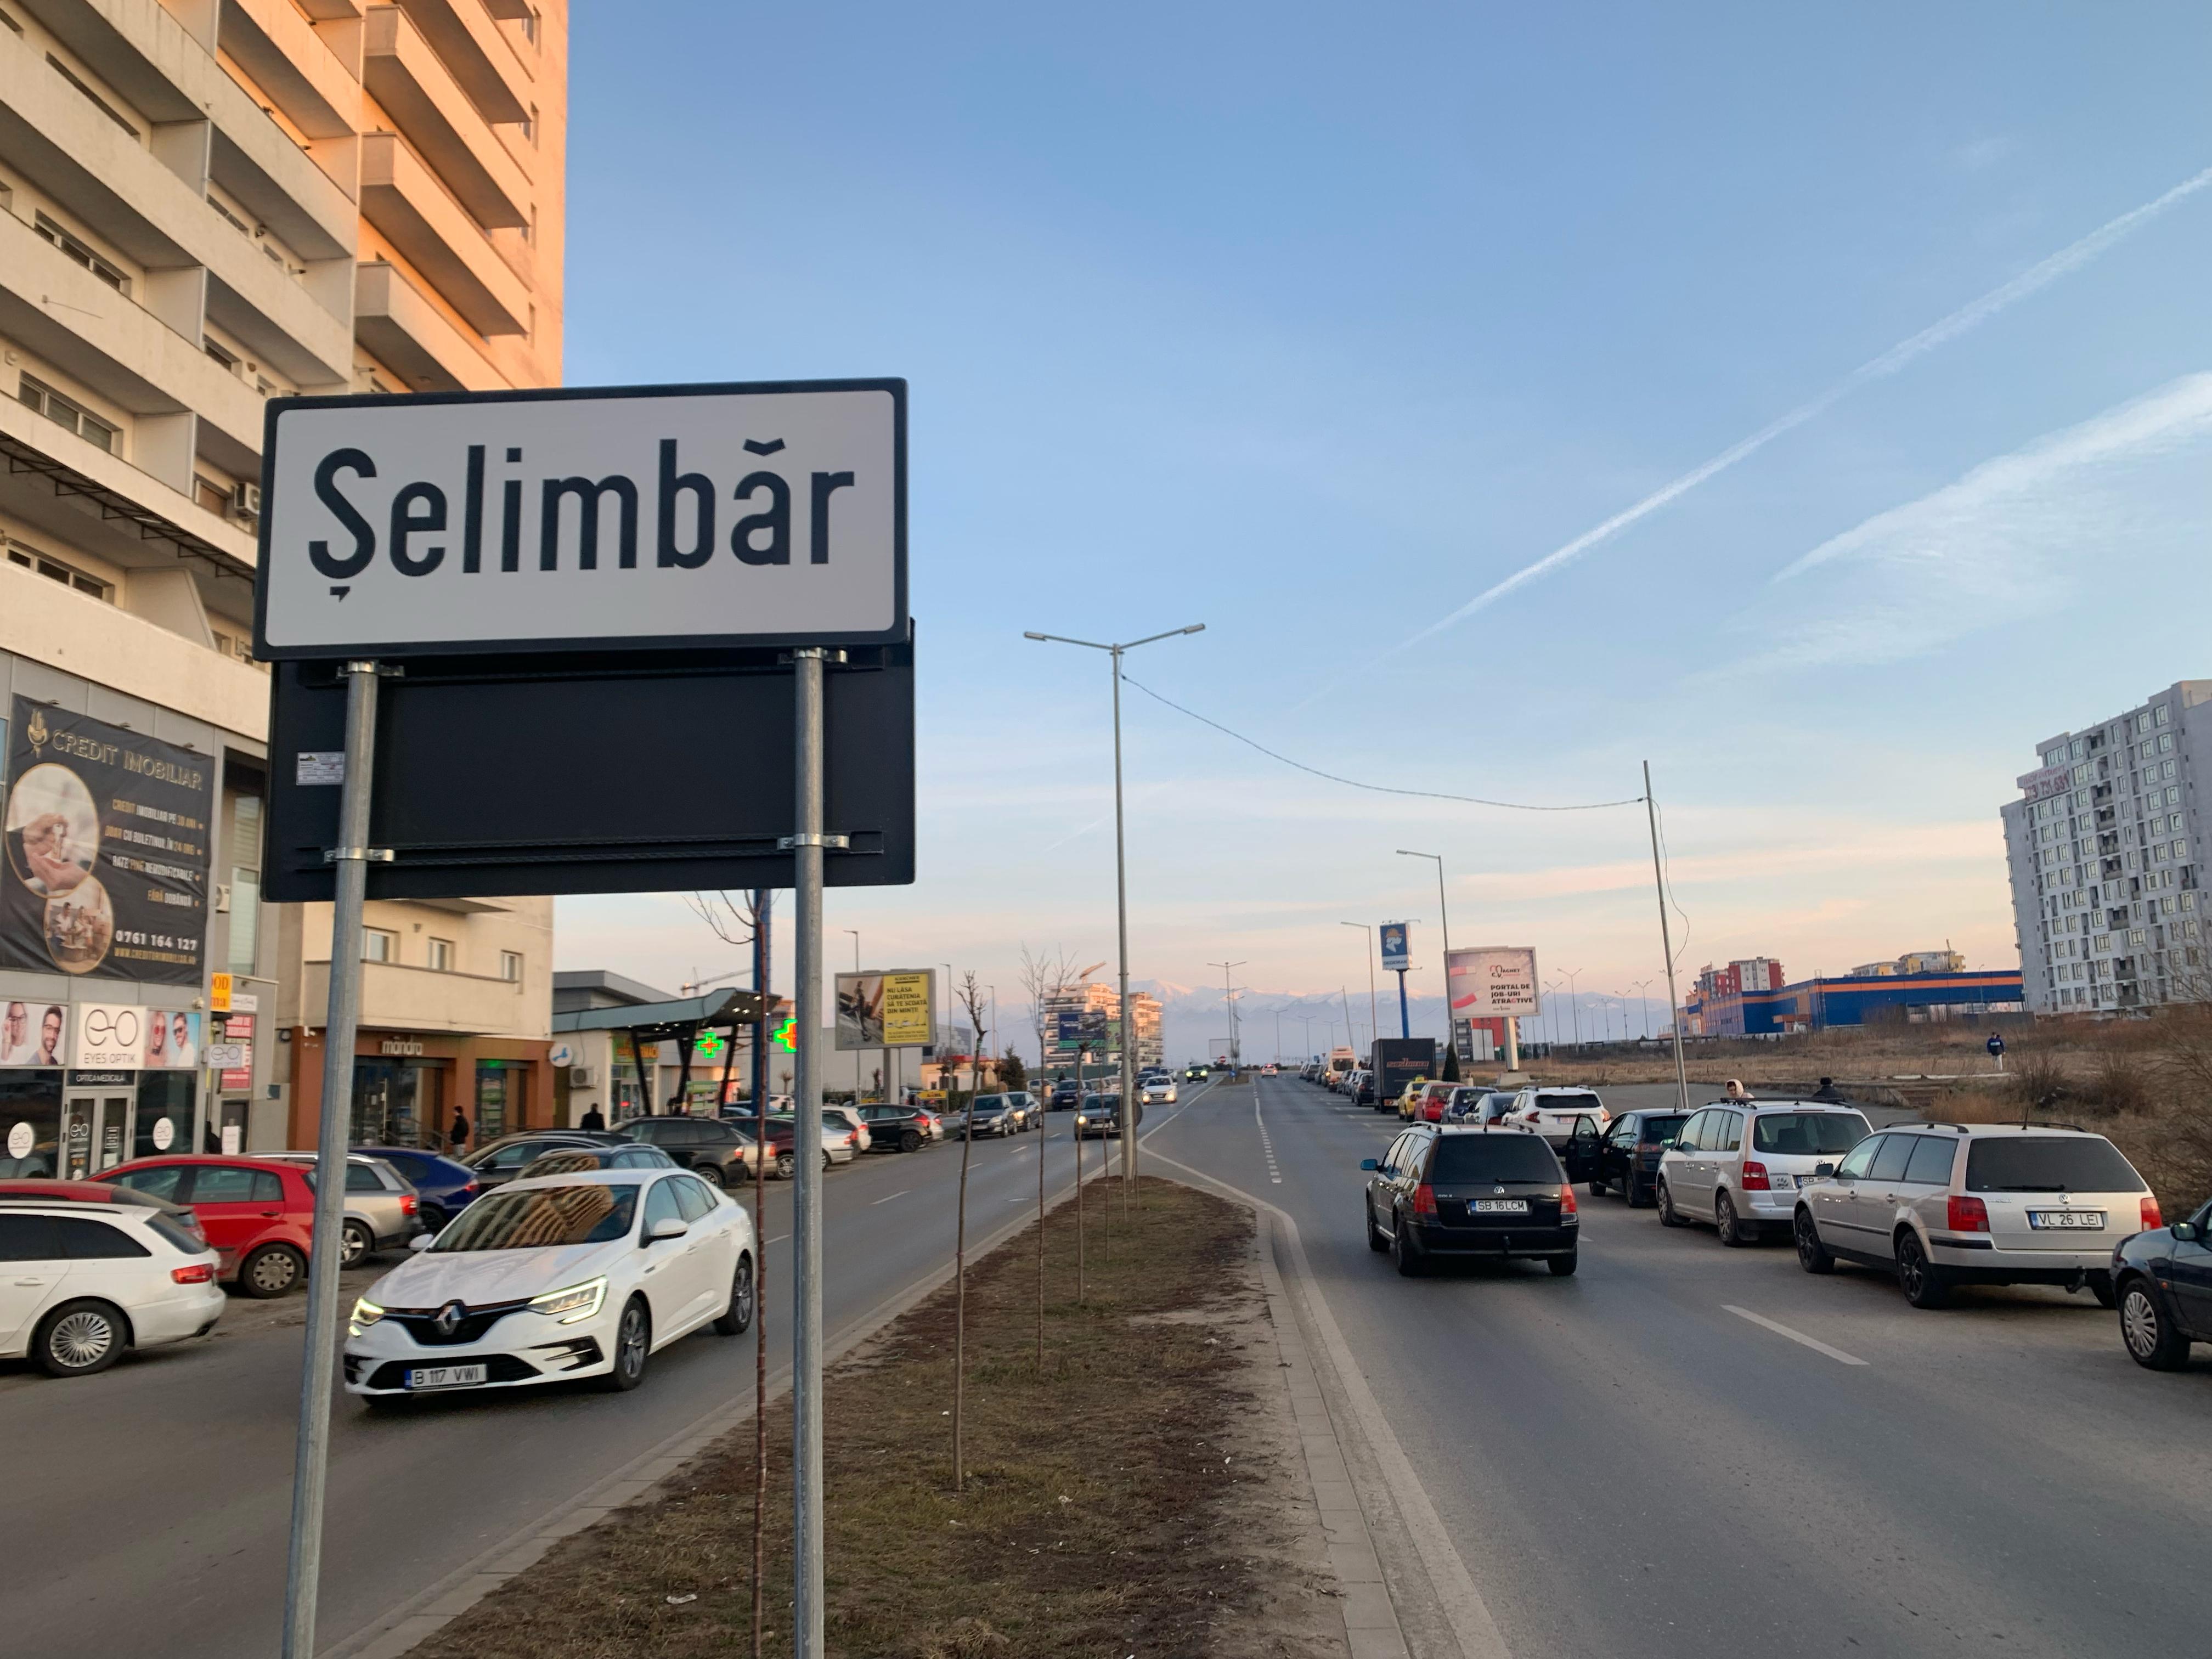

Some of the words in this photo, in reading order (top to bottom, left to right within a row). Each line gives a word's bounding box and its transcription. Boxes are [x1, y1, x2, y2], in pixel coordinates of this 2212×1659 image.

[309, 439, 854, 602] Șelimbăr
[53, 729, 119, 765] CREDIT
[123, 750, 203, 791] IMOBILIAR
[123, 830, 133, 841] CU
[133, 831, 165, 849] BULETINUL
[115, 930, 146, 945] 0761
[151, 934, 173, 948] 164
[177, 938, 198, 951] 127
[84, 1053, 106, 1064] EYES
[110, 1053, 136, 1064] OPTIK
[1478, 1200, 1492, 1210] SB
[1495, 1200, 1504, 1210] 16
[1504, 1200, 1525, 1210] LCM
[2039, 1214, 2055, 1225] VL
[2059, 1214, 2074, 1225] 26
[2080, 1214, 2098, 1225] LEI
[415, 1371, 424, 1385] B
[429, 1369, 446, 1383] 117
[454, 1367, 478, 1381] VWI
